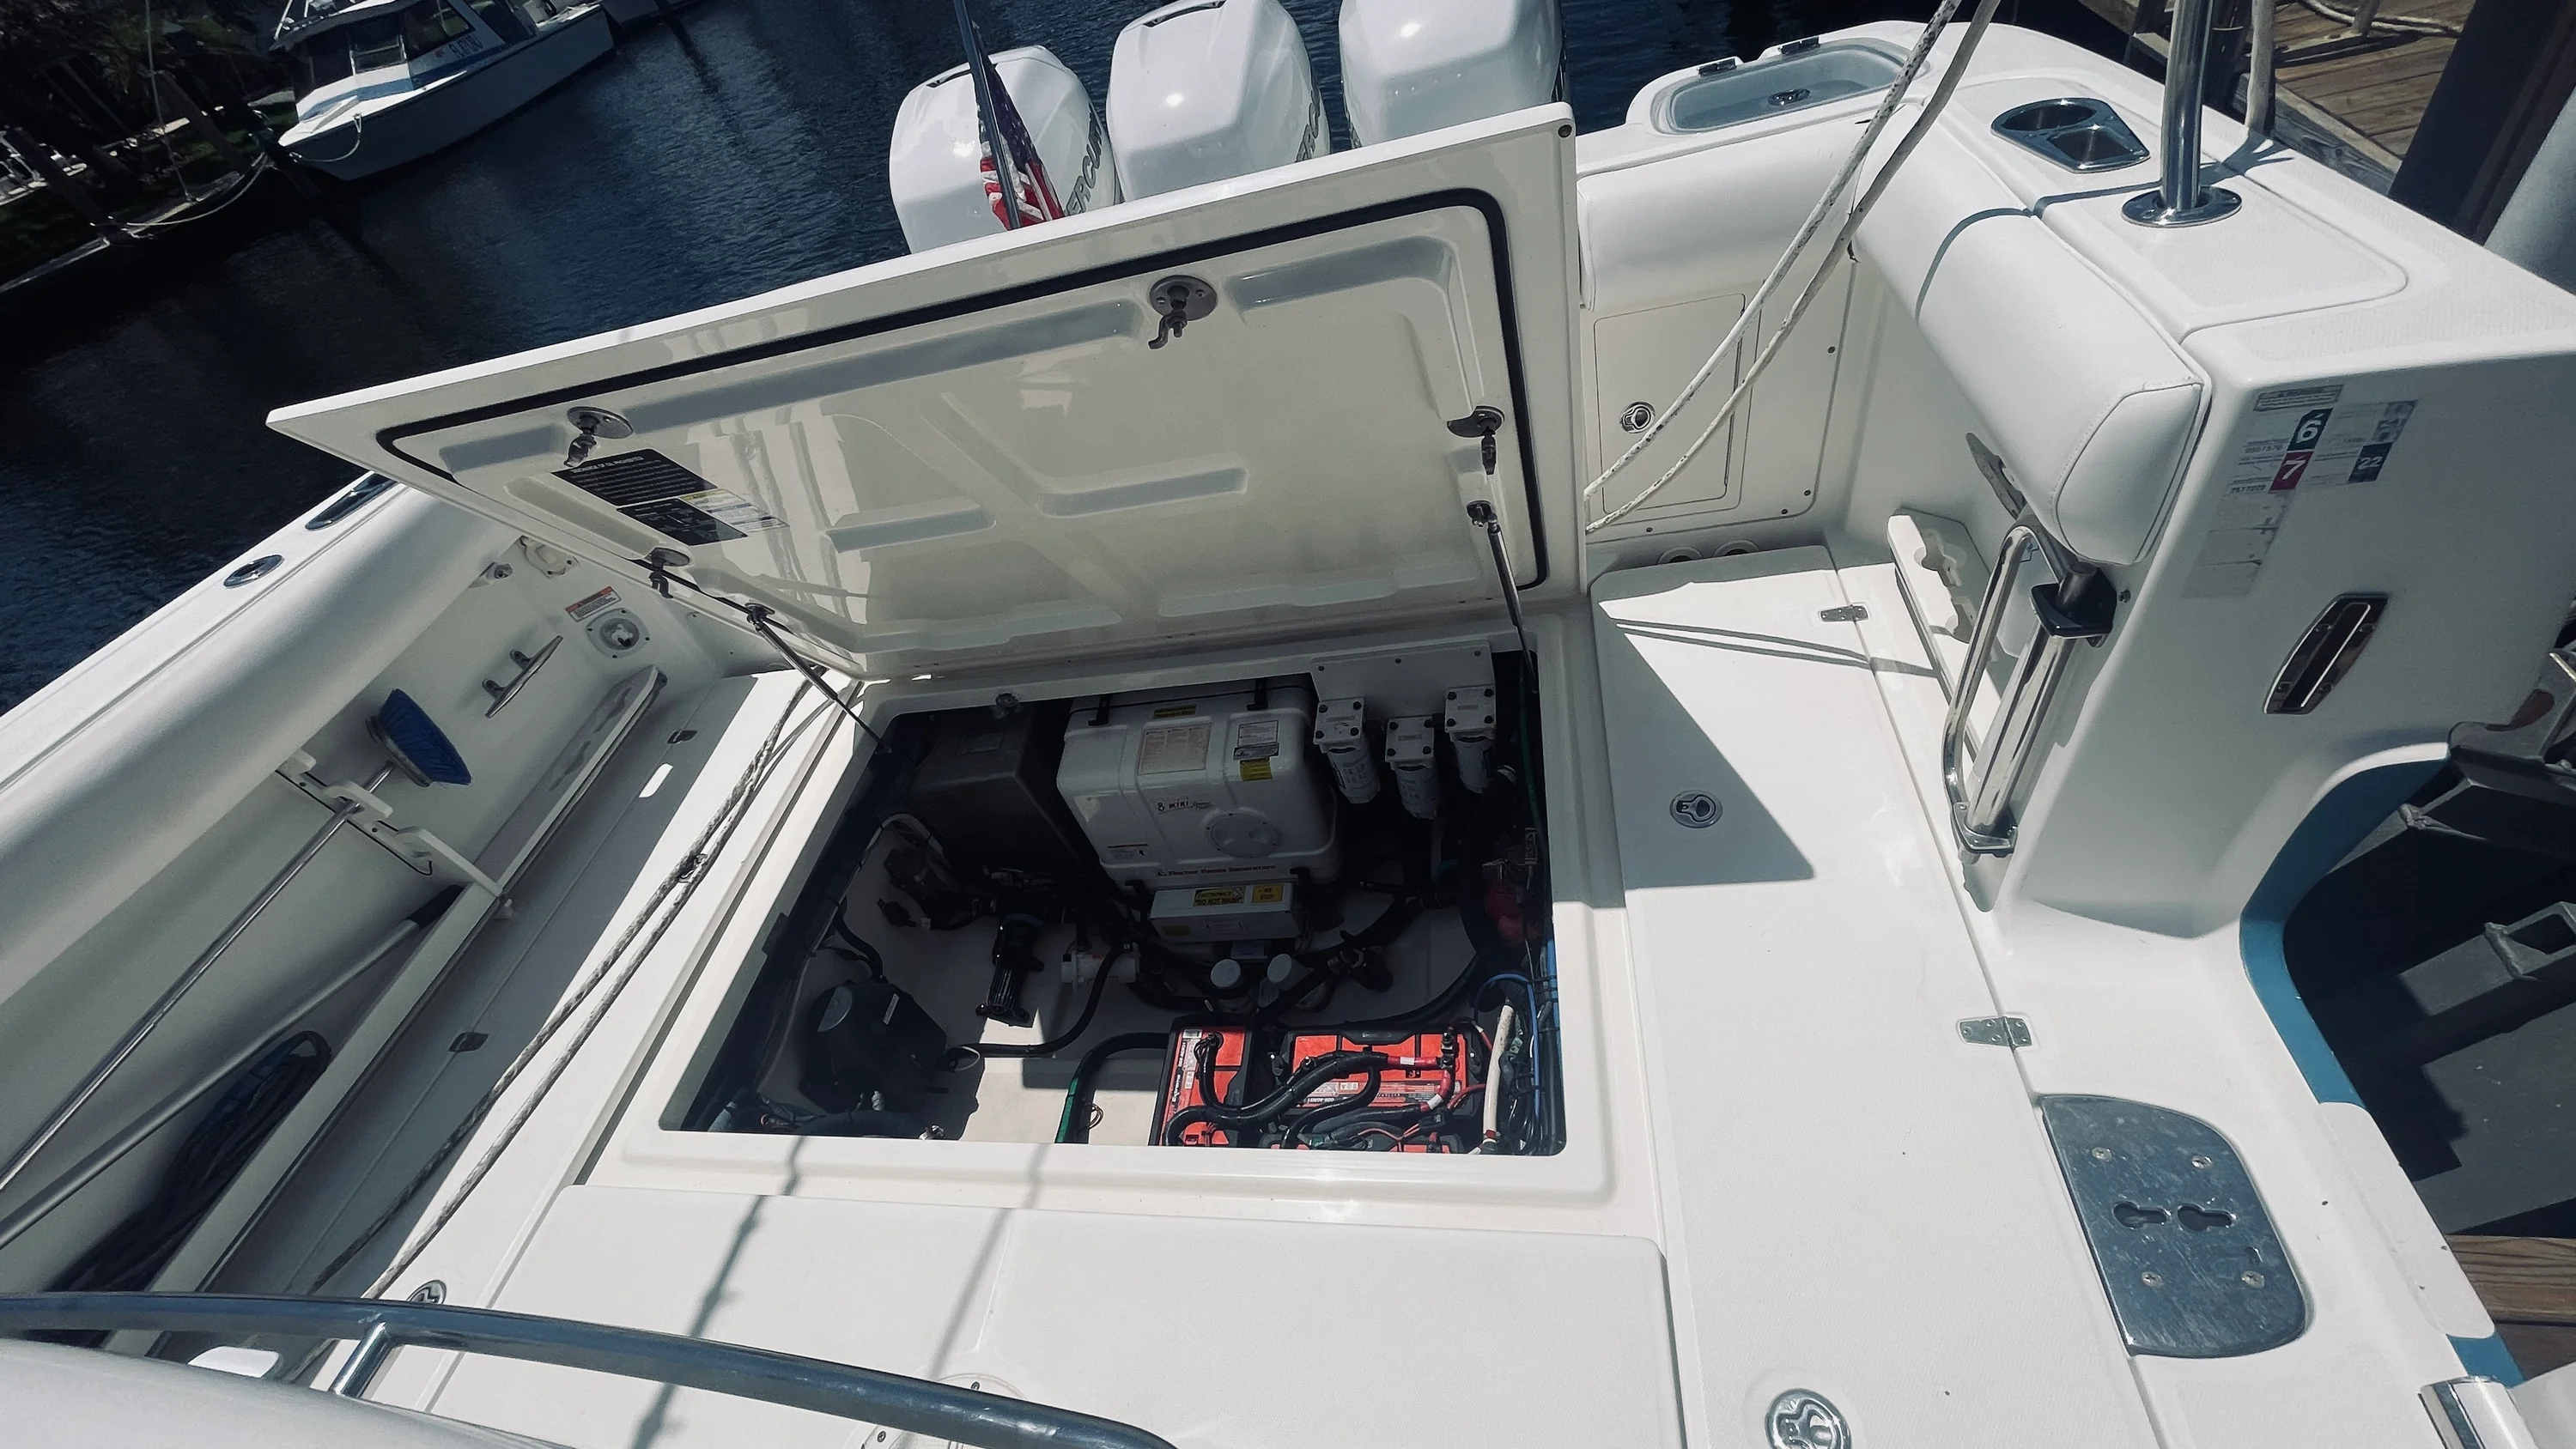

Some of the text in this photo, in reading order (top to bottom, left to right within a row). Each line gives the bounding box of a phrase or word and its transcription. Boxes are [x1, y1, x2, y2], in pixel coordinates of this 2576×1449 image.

[2295, 419, 2322, 444] 6
[2281, 459, 2306, 480] 7
[2357, 456, 2384, 471] 22
